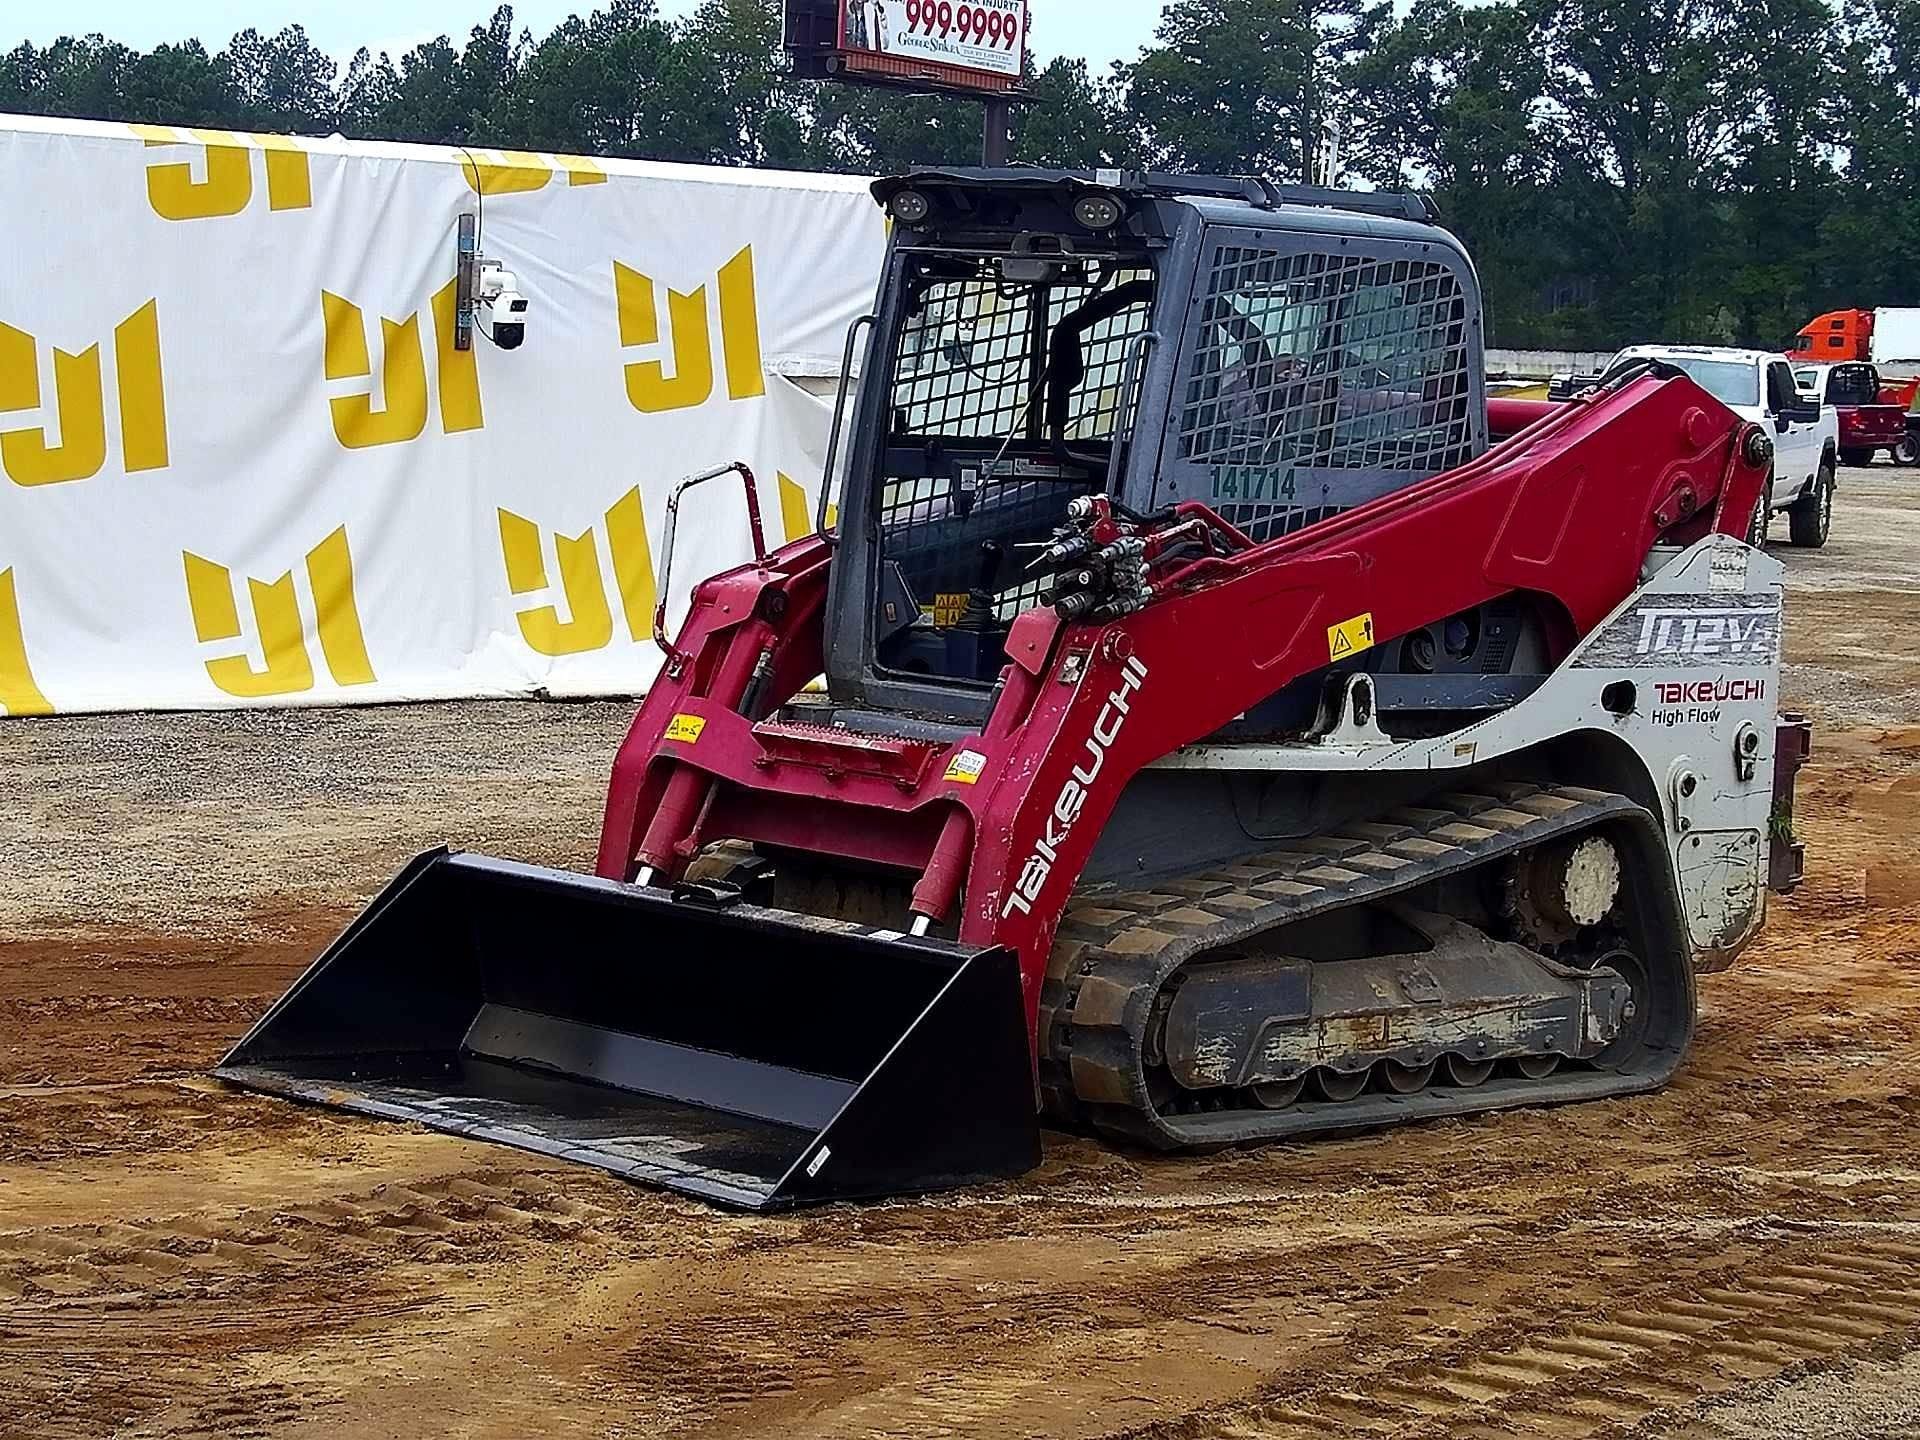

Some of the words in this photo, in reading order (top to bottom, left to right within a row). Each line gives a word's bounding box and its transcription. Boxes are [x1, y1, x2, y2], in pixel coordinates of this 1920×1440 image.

[1210, 466, 1296, 500] 141714
[1654, 679, 1765, 704] TAKEUCHI
[1652, 710, 1684, 727] High
[1688, 708, 1721, 723] Flow
